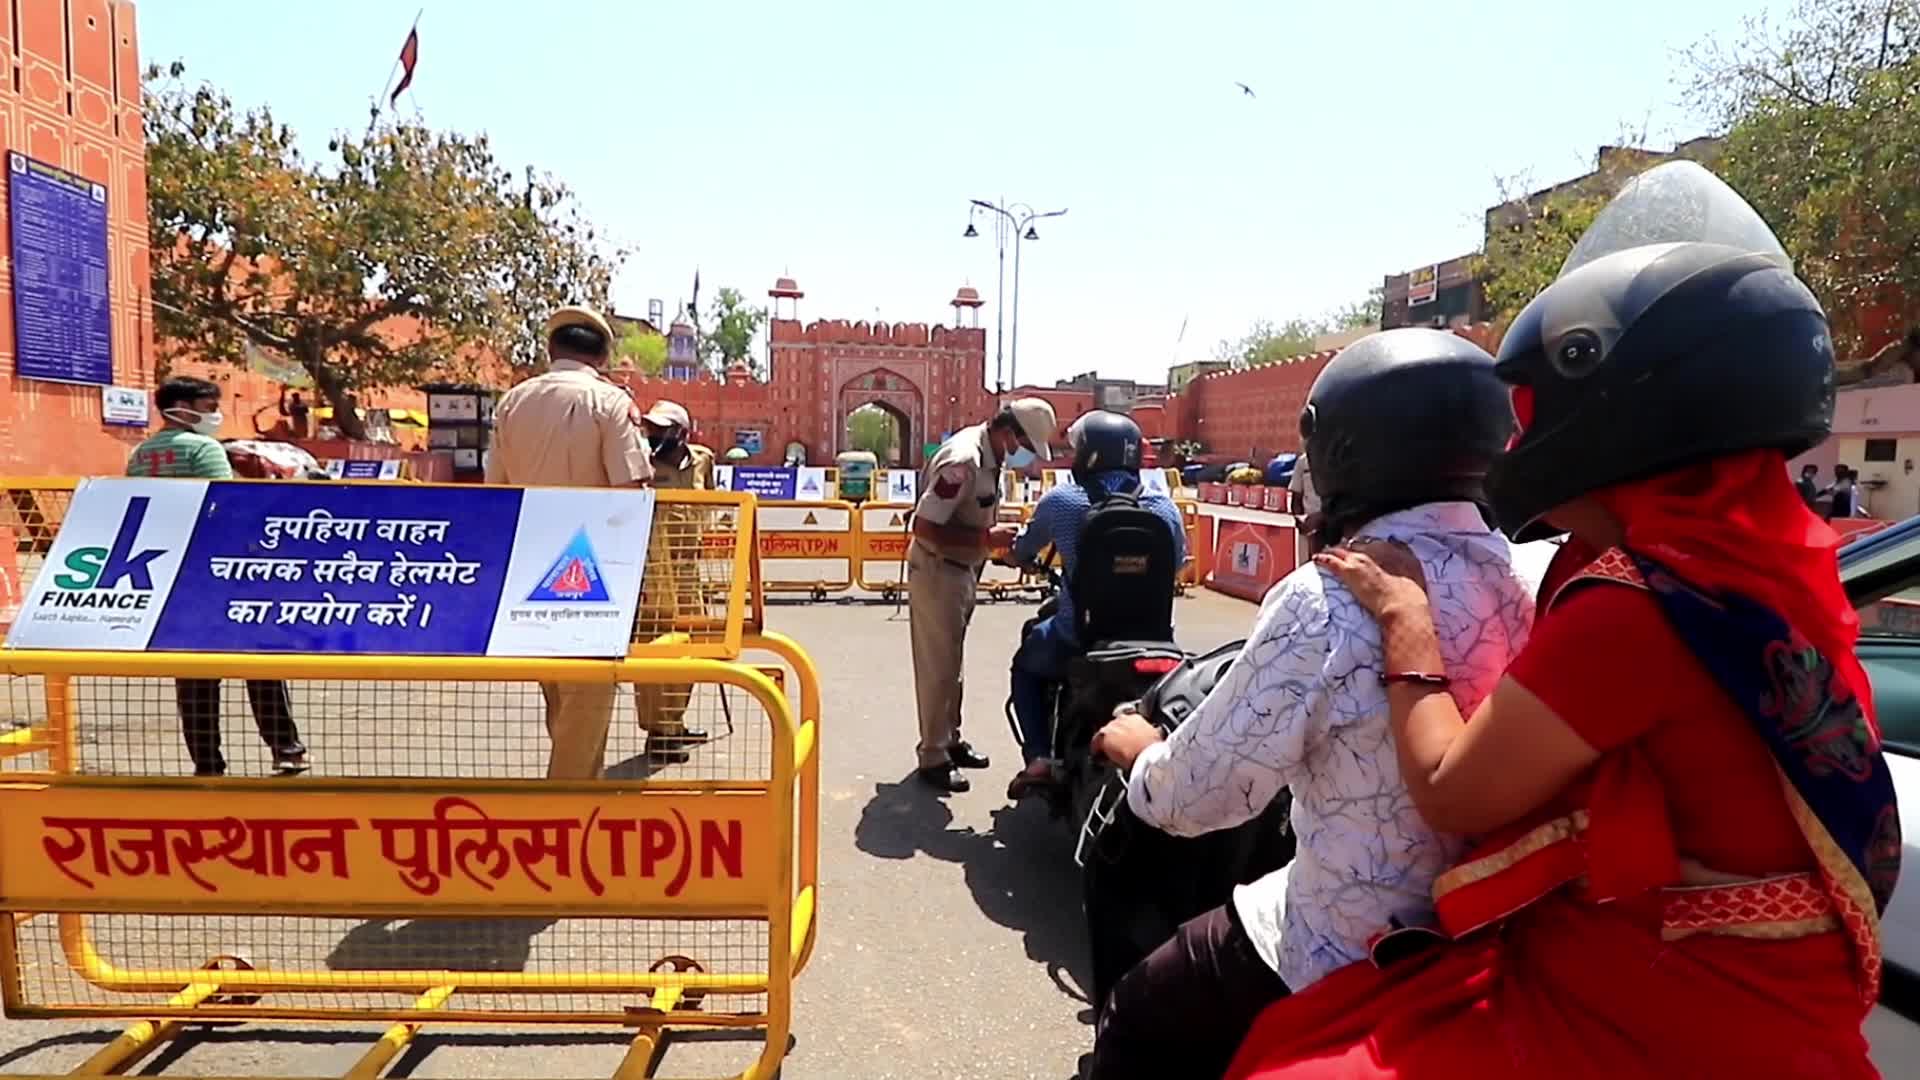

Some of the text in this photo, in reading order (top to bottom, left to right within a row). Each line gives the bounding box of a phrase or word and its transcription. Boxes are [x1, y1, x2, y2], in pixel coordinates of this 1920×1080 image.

[259, 508, 450, 549] दुपहिया वाहन
[210, 550, 481, 586] चालक सदैव हेलमेट
[40, 591, 152, 610] FINANCE
[227, 600, 273, 624] का
[276, 592, 362, 625] प्रयोग
[42, 815, 360, 892] राजस्थान
